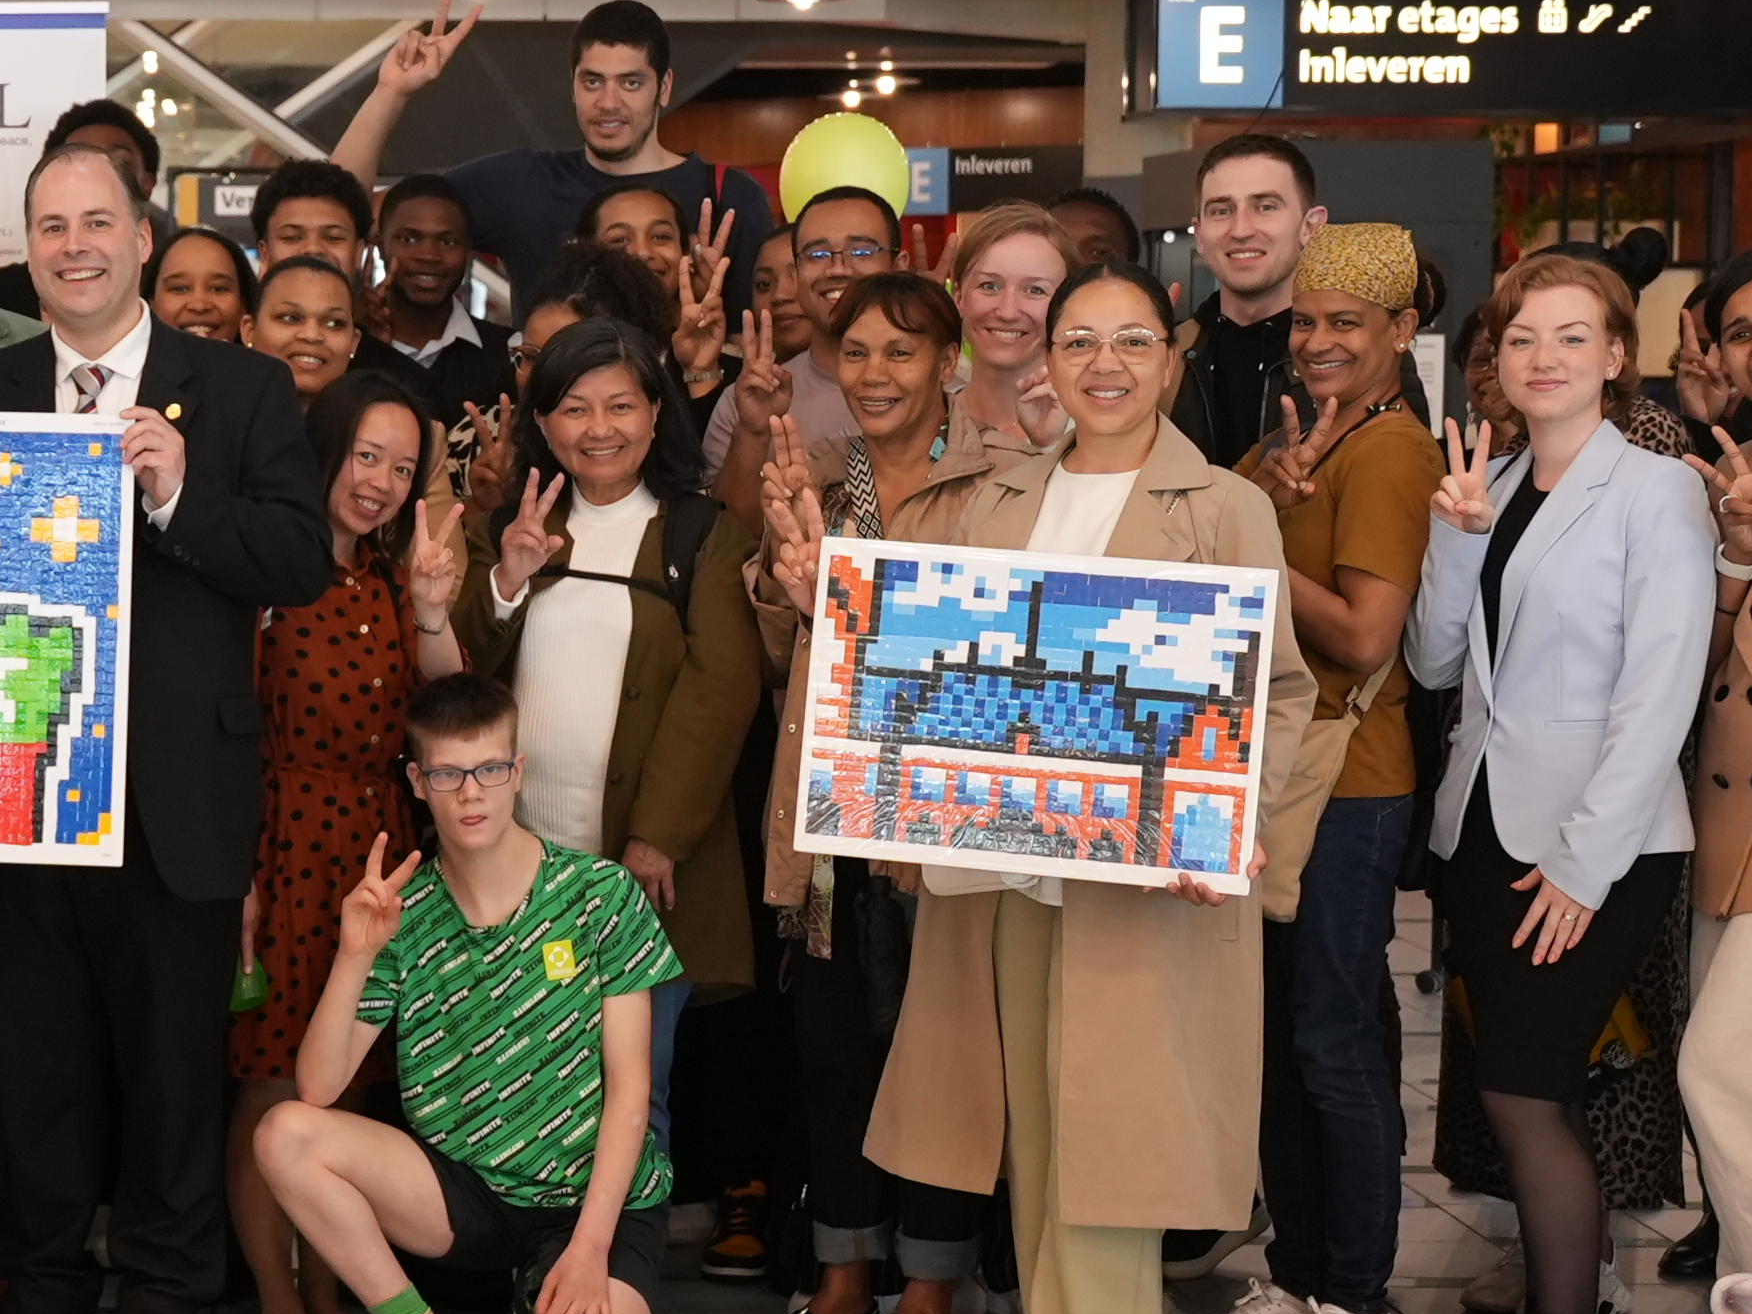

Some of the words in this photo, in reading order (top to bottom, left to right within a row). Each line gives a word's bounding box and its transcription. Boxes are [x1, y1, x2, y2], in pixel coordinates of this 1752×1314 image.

[1300, 0, 1392, 33] Naar
[1398, 0, 1518, 43] etages
[1199, 5, 1246, 84] E
[1299, 47, 1470, 83] Inleveren
[911, 161, 932, 202] E
[955, 155, 1032, 174] Inleveren
